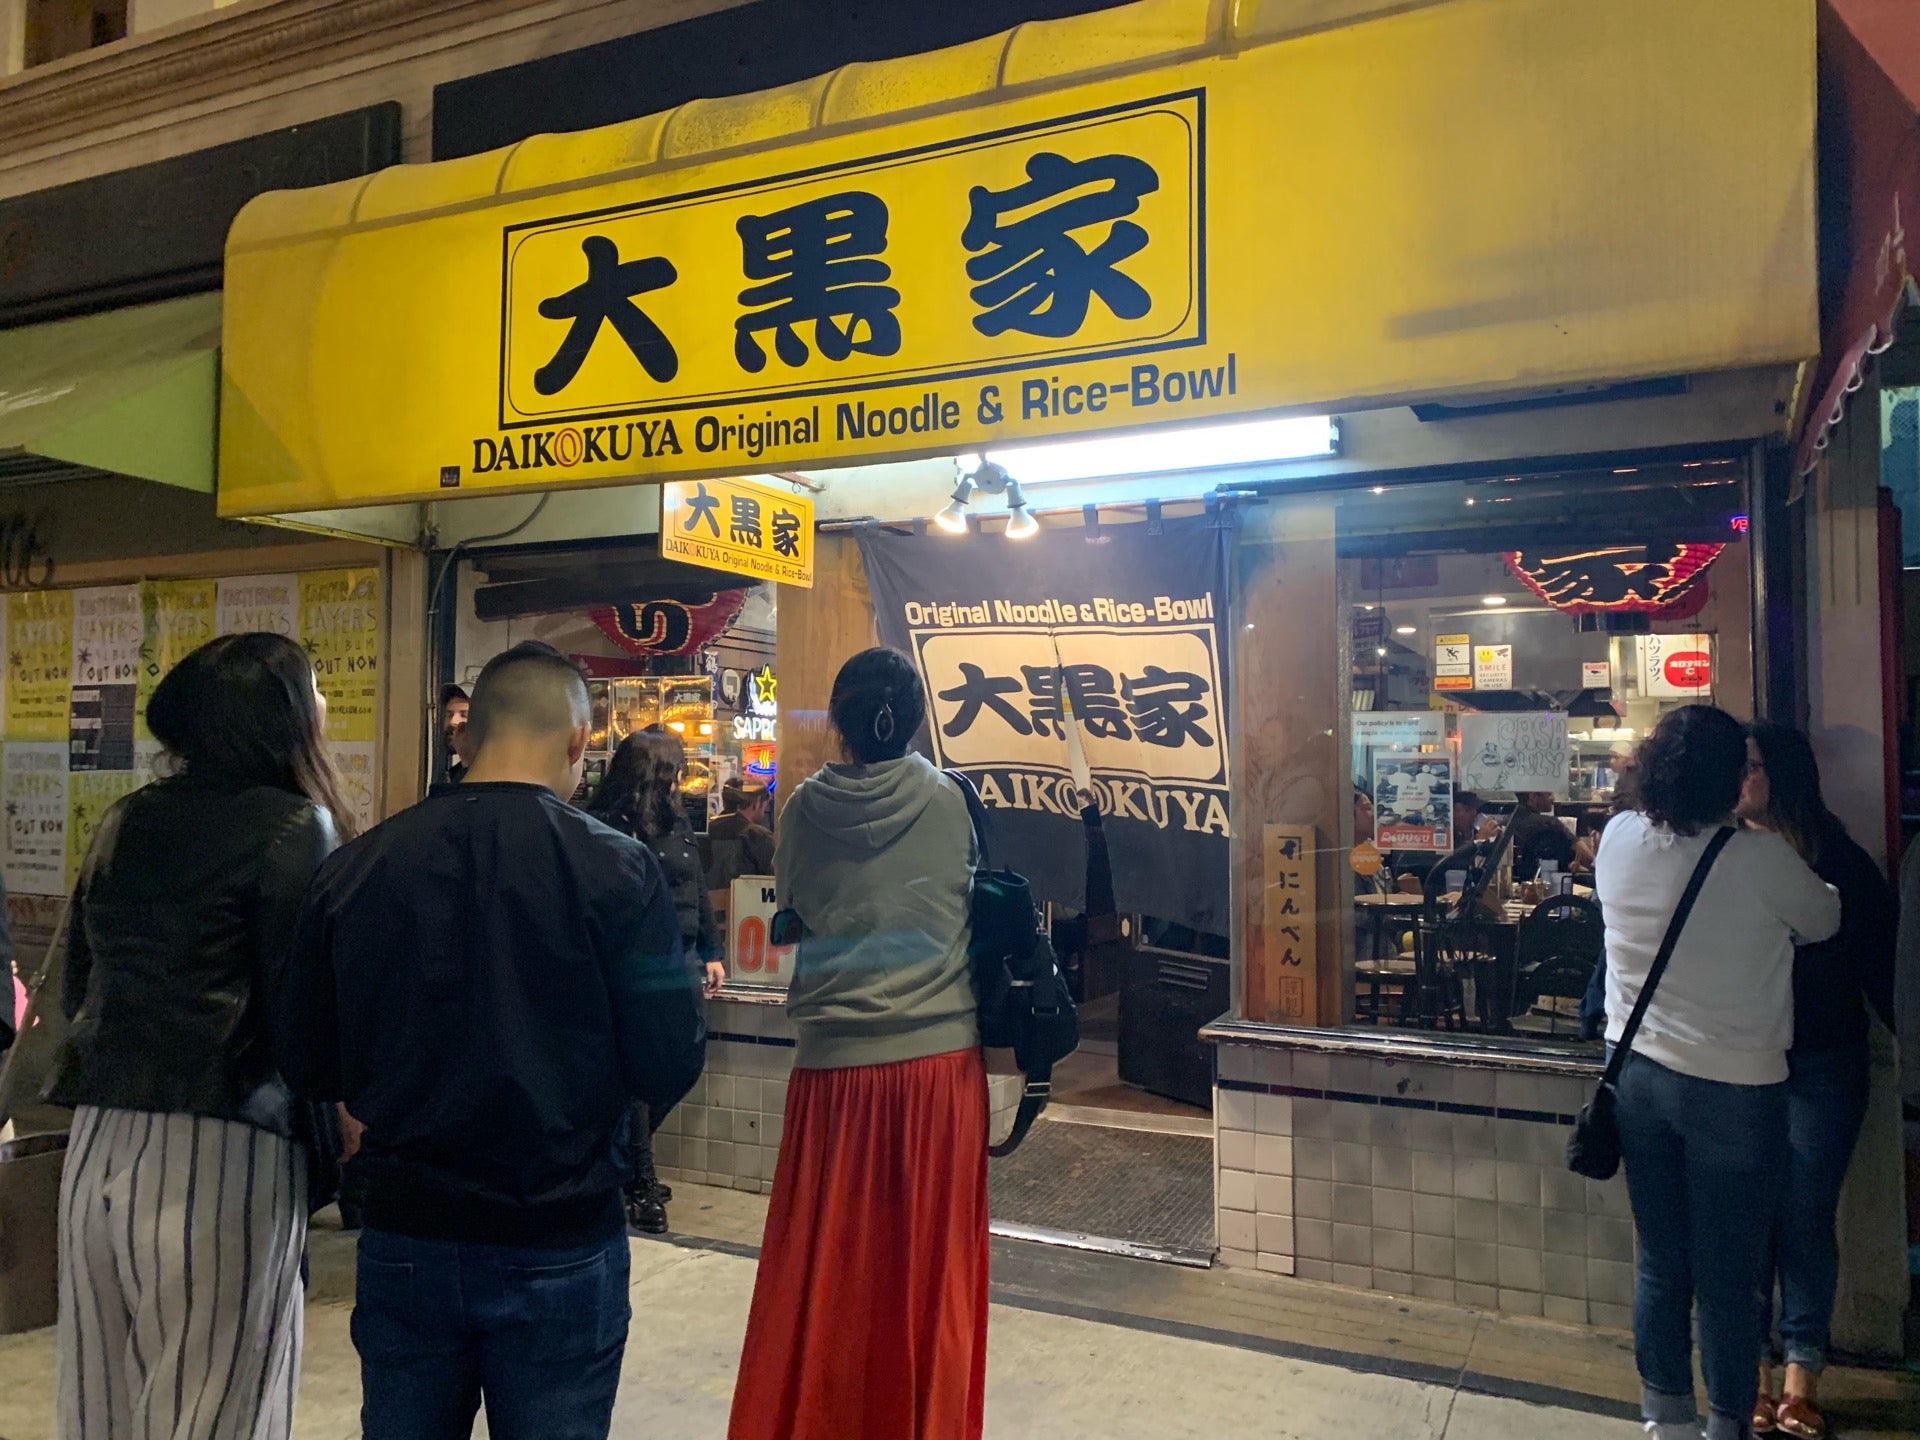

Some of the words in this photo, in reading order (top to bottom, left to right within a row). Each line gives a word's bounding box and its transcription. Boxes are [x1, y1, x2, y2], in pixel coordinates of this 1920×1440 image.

[534, 152, 1159, 395] 大黒家
[473, 419, 682, 472] DAIKOKUYA
[695, 406, 818, 457] Original
[836, 393, 959, 440] Noodle
[977, 386, 1003, 424] &
[1022, 353, 1236, 419] Rice-Bowl
[684, 482, 800, 557] 大黒家
[665, 538, 720, 561] DAIKOKUYA
[722, 552, 748, 568] Original
[751, 559, 773, 573] Noodle
[775, 564, 780, 575] &
[782, 565, 811, 581] Rice-Bowl
[905, 600, 991, 627] Original
[994, 600, 1077, 623] Noodle
[1079, 604, 1095, 622] &
[1093, 592, 1214, 623] Rice-Bowl
[20, 667, 40, 683] OUT
[44, 665, 68, 680] NOW
[87, 665, 110, 682] OUT
[315, 657, 341, 675] OUT
[347, 655, 377, 673] NOW
[938, 662, 1214, 748] 大黒家
[1498, 716, 1567, 751] CASH
[14, 818, 36, 836] OUT
[40, 818, 63, 835] NOW
[979, 773, 1232, 838] AIKOKUYA
[1279, 870, 1302, 967] にんべん
